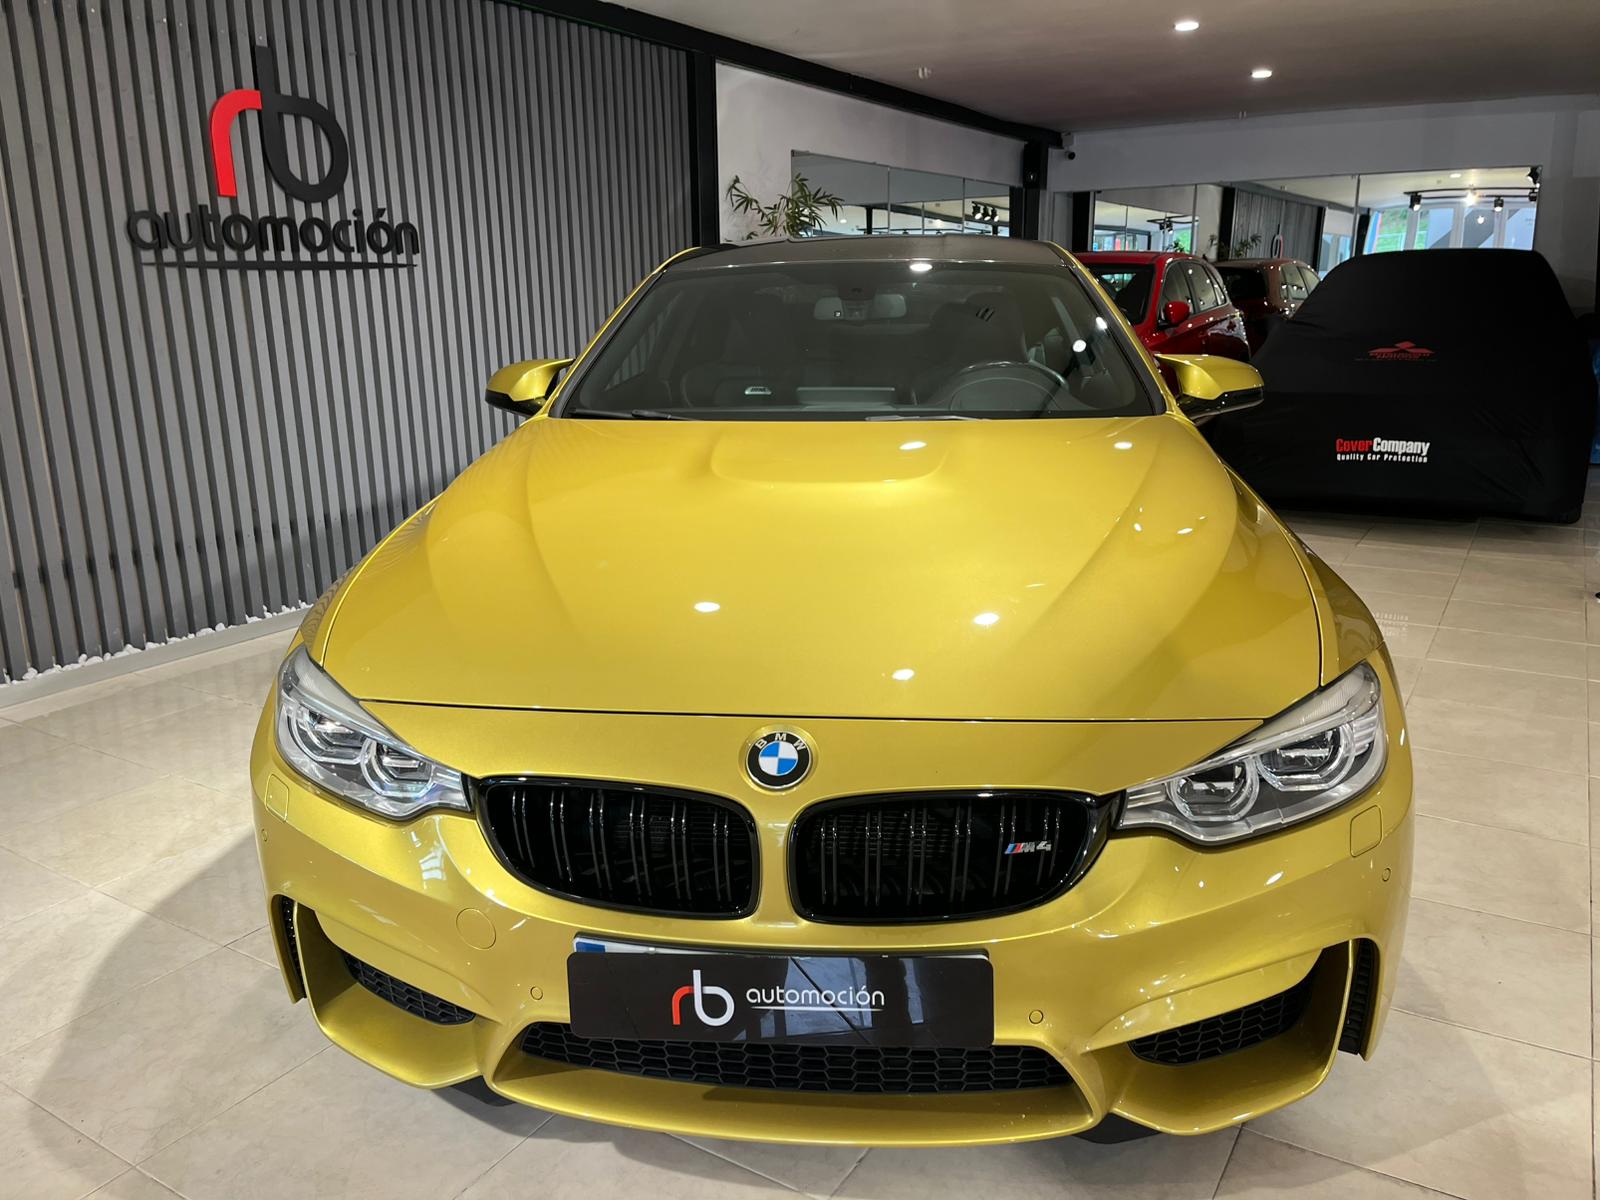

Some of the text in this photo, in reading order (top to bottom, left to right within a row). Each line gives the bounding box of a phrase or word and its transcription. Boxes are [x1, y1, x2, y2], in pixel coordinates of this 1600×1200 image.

[210, 45, 349, 203] rb
[126, 204, 420, 255] automoción
[1336, 453, 1428, 463] Quality Car Protection
[755, 733, 807, 751] BMW
[671, 969, 885, 1027] rb automoción
